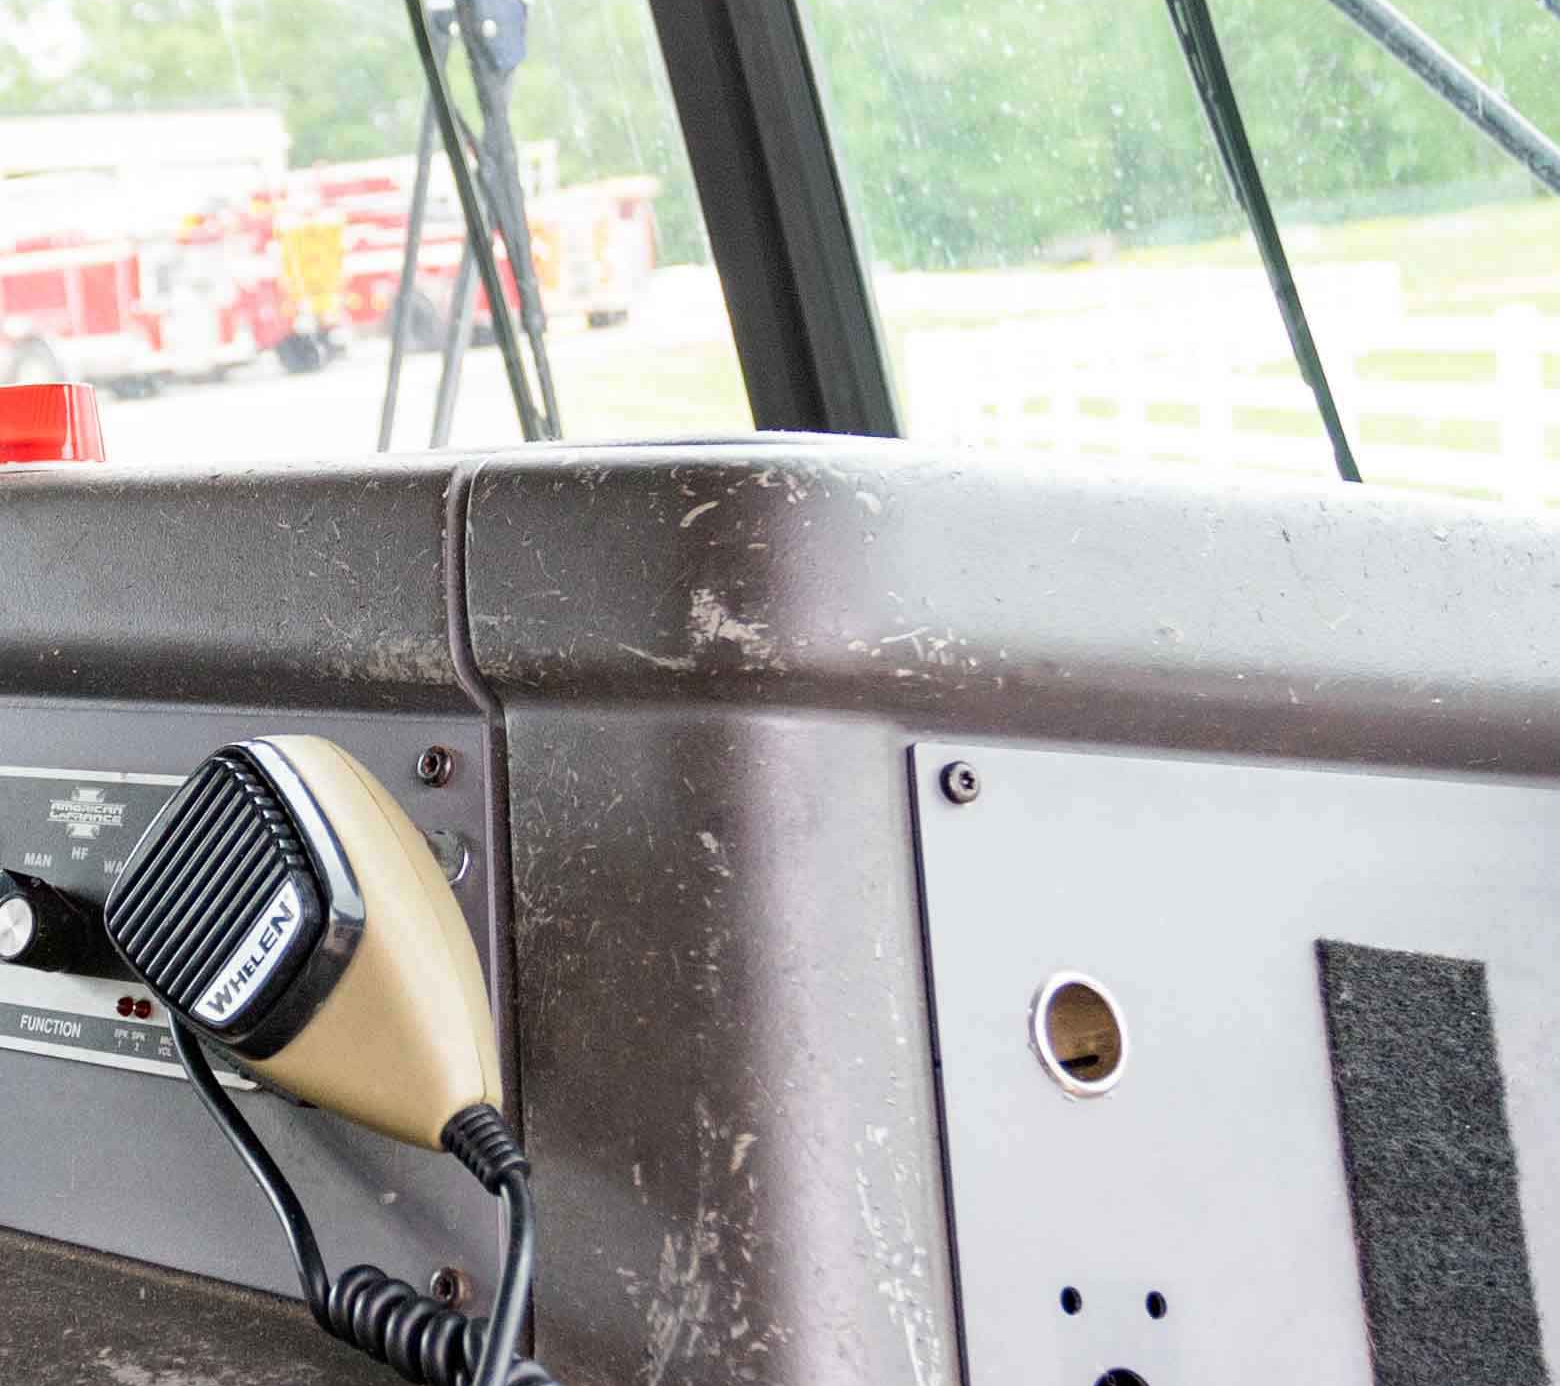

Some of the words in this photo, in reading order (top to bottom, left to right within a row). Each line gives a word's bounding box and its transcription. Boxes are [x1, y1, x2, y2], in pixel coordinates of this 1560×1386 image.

[24, 852, 52, 868] MAN
[71, 846, 88, 861] HF
[103, 860, 122, 875] WA
[206, 901, 295, 1015] WHELEN
[19, 1014, 81, 1038] FUNCTION
